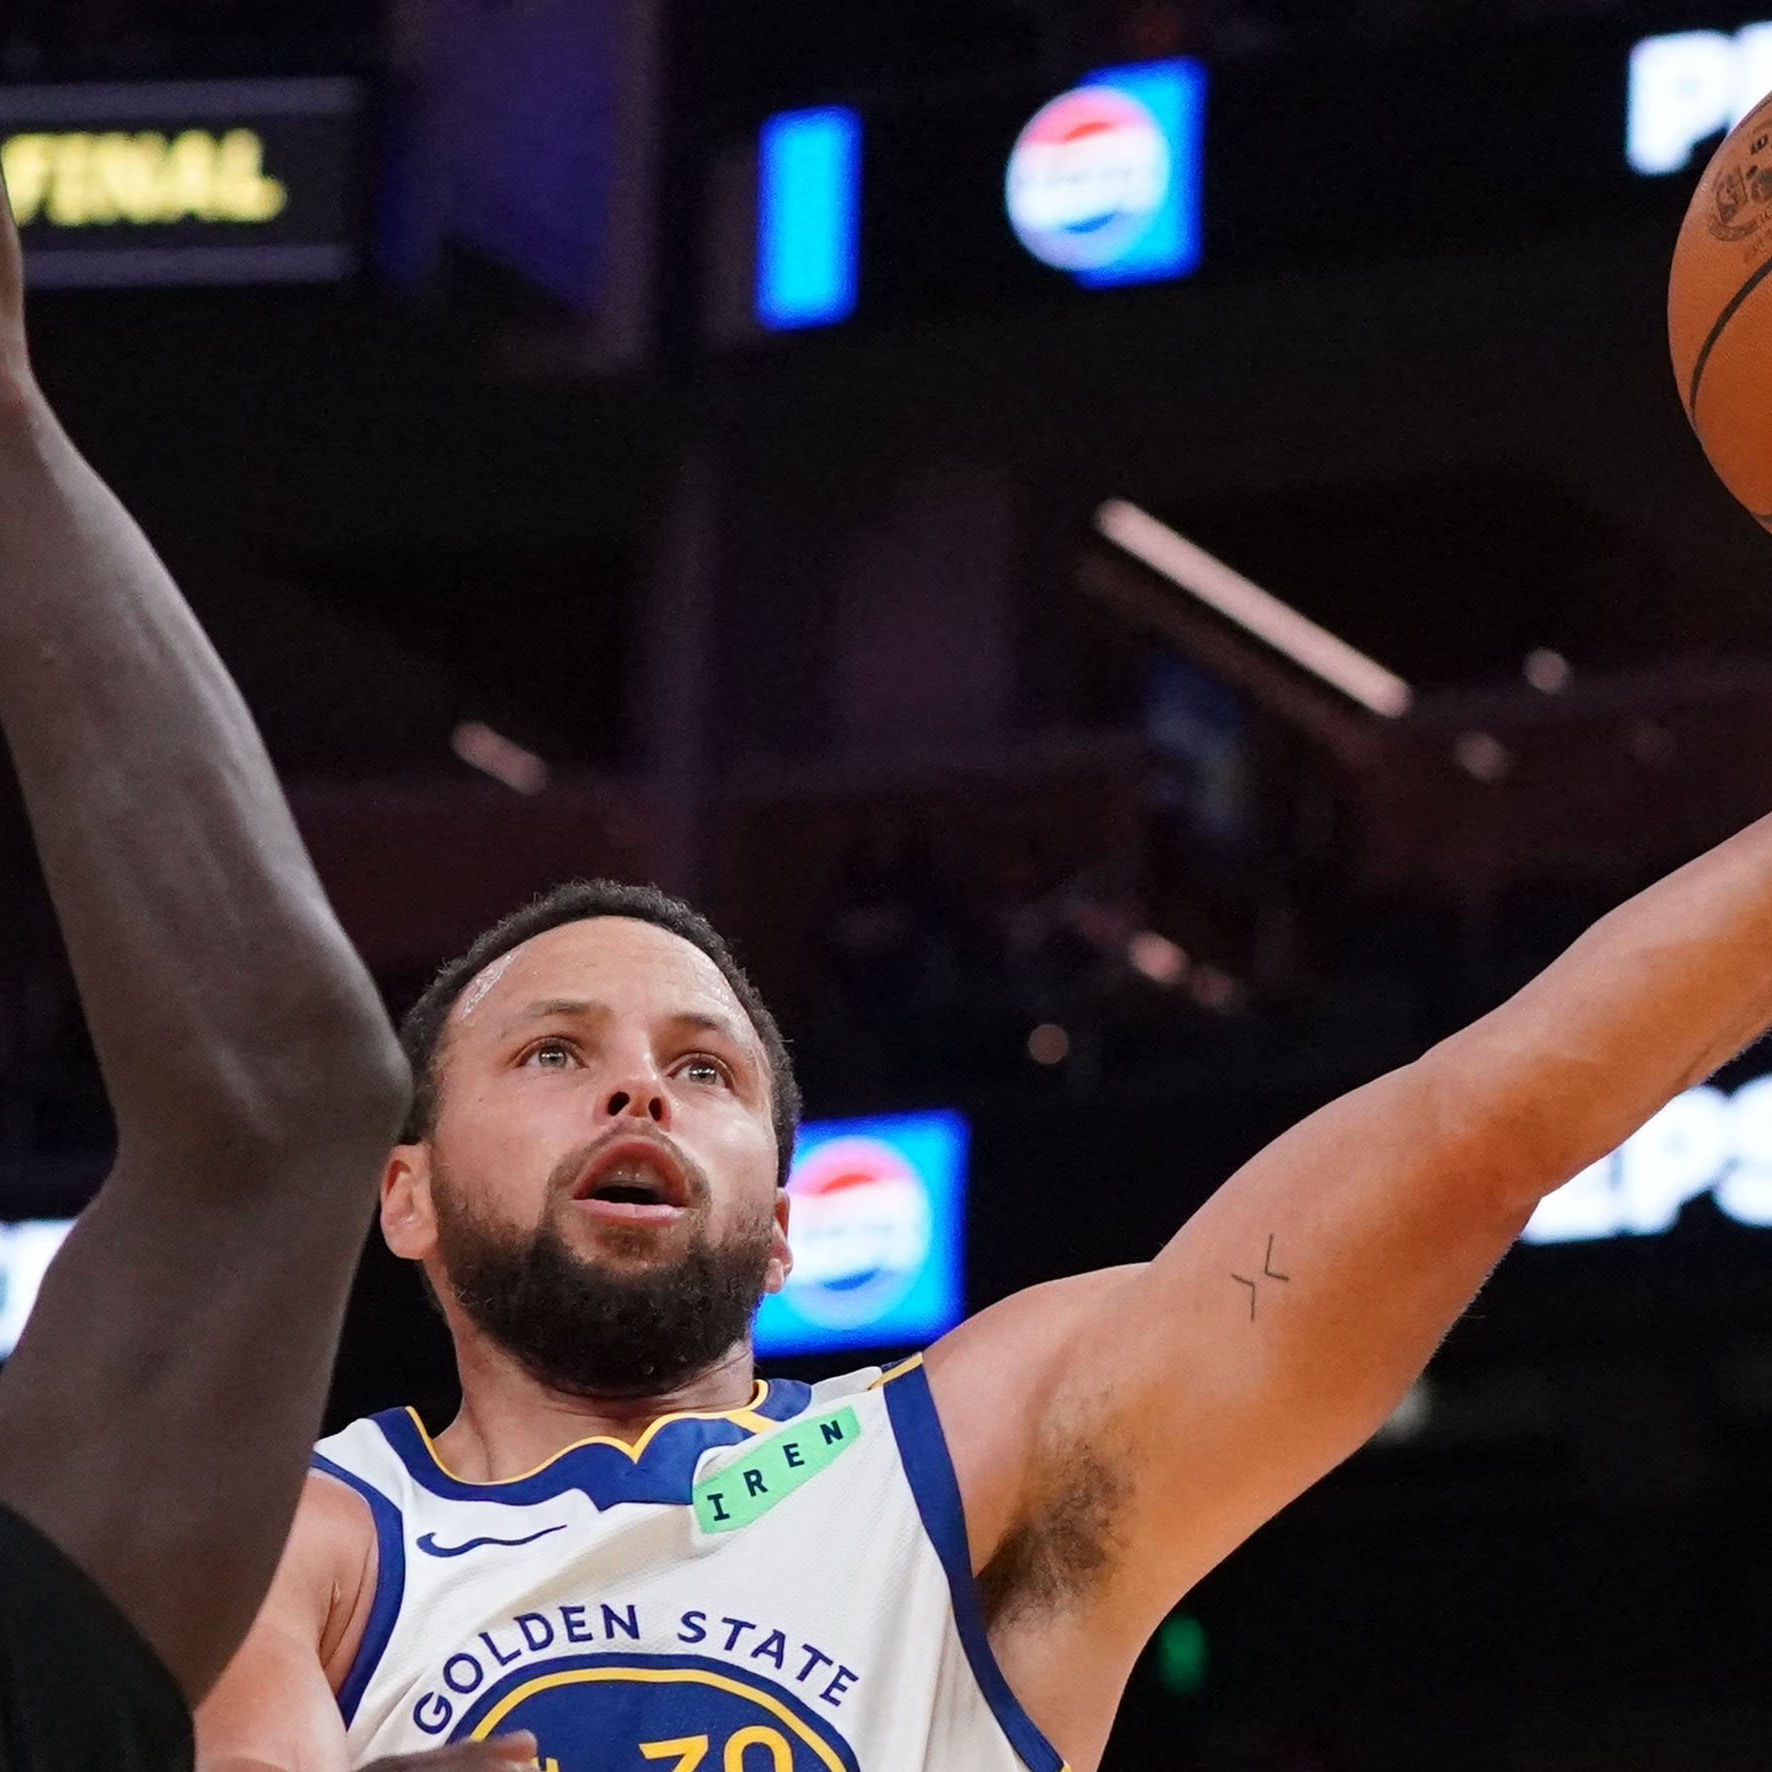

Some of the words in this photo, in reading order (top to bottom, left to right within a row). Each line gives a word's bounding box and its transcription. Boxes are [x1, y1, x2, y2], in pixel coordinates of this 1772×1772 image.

[0, 128, 289, 228] FINAL
[706, 1419, 844, 1522] IREN
[412, 1603, 641, 1735] GOLDEN
[676, 1609, 860, 1708] STATE
